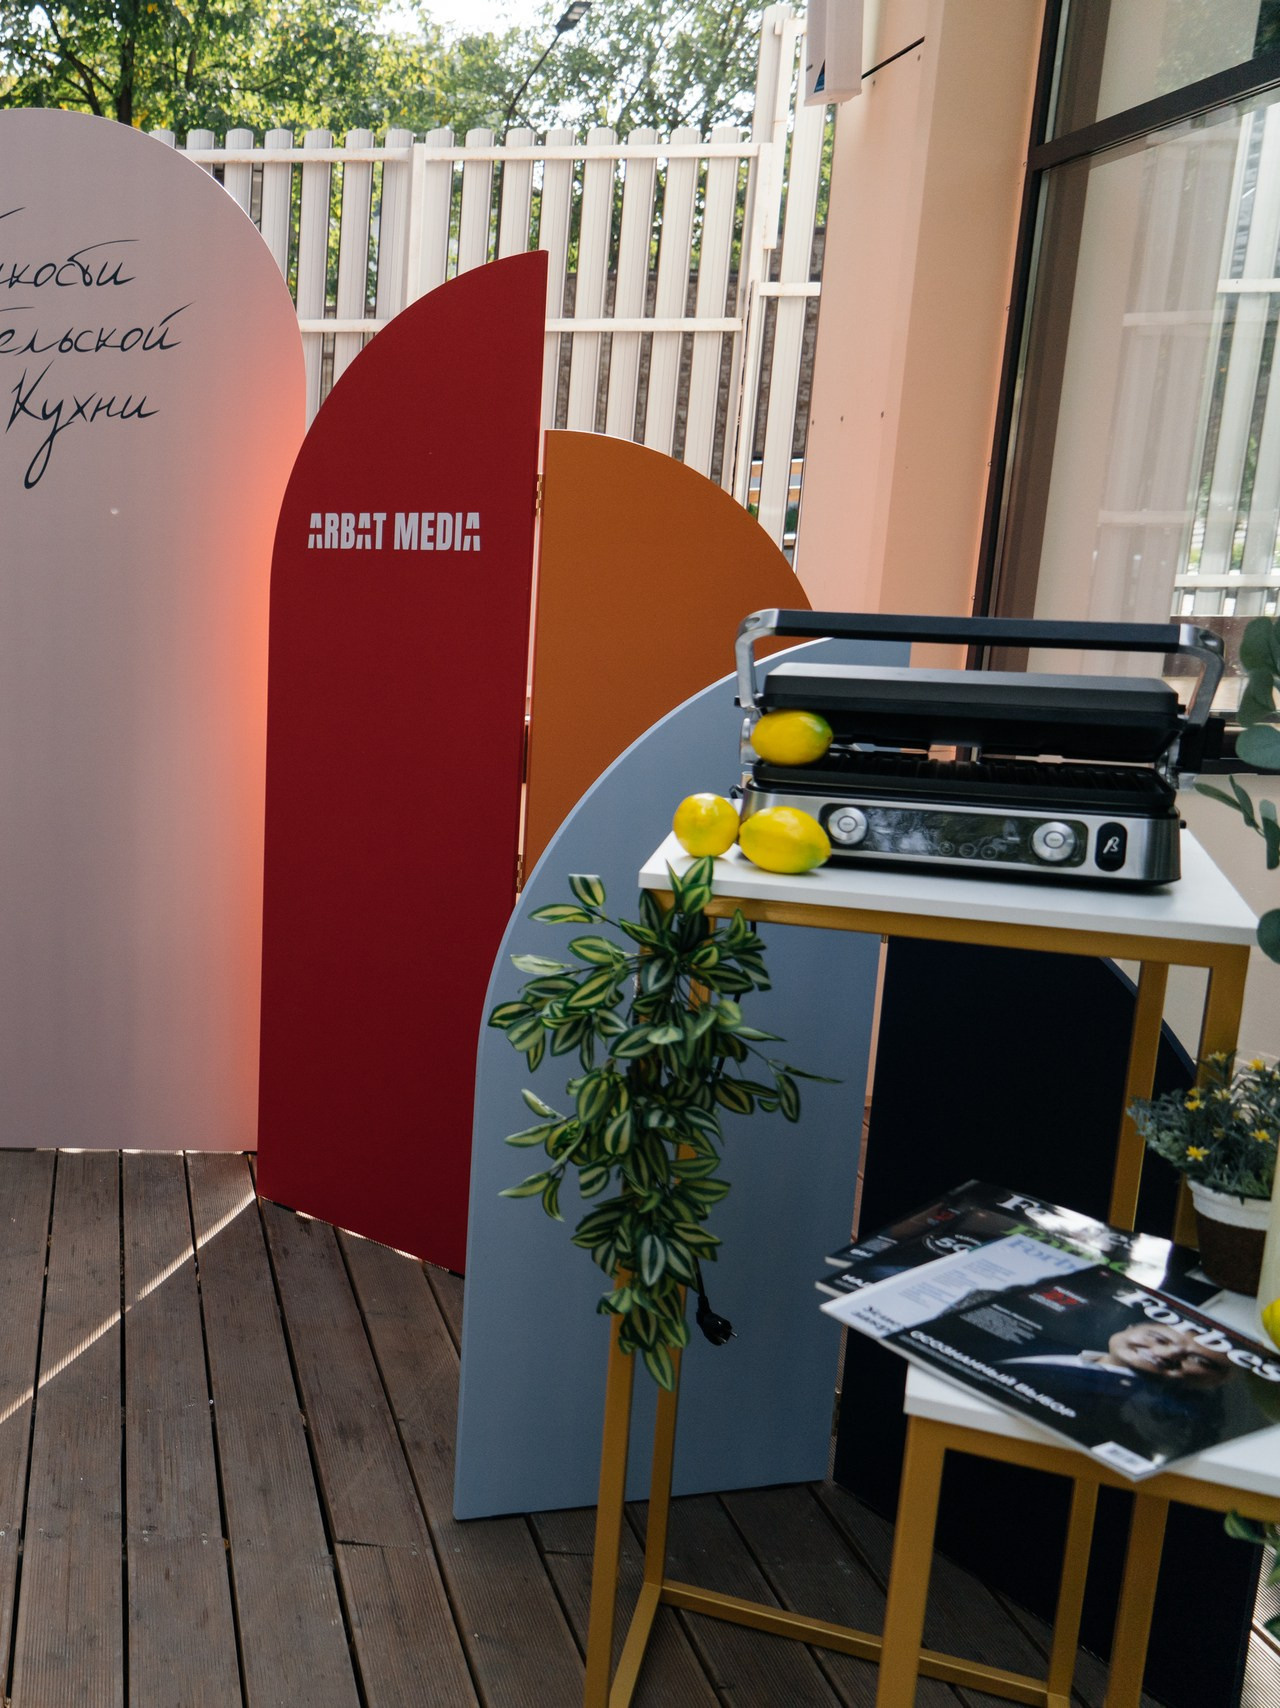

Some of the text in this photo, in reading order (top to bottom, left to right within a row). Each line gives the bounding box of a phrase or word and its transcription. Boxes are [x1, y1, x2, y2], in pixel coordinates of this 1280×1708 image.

[5, 359, 161, 490] Кухни
[307, 512, 481, 551] ARBAT MEDIA
